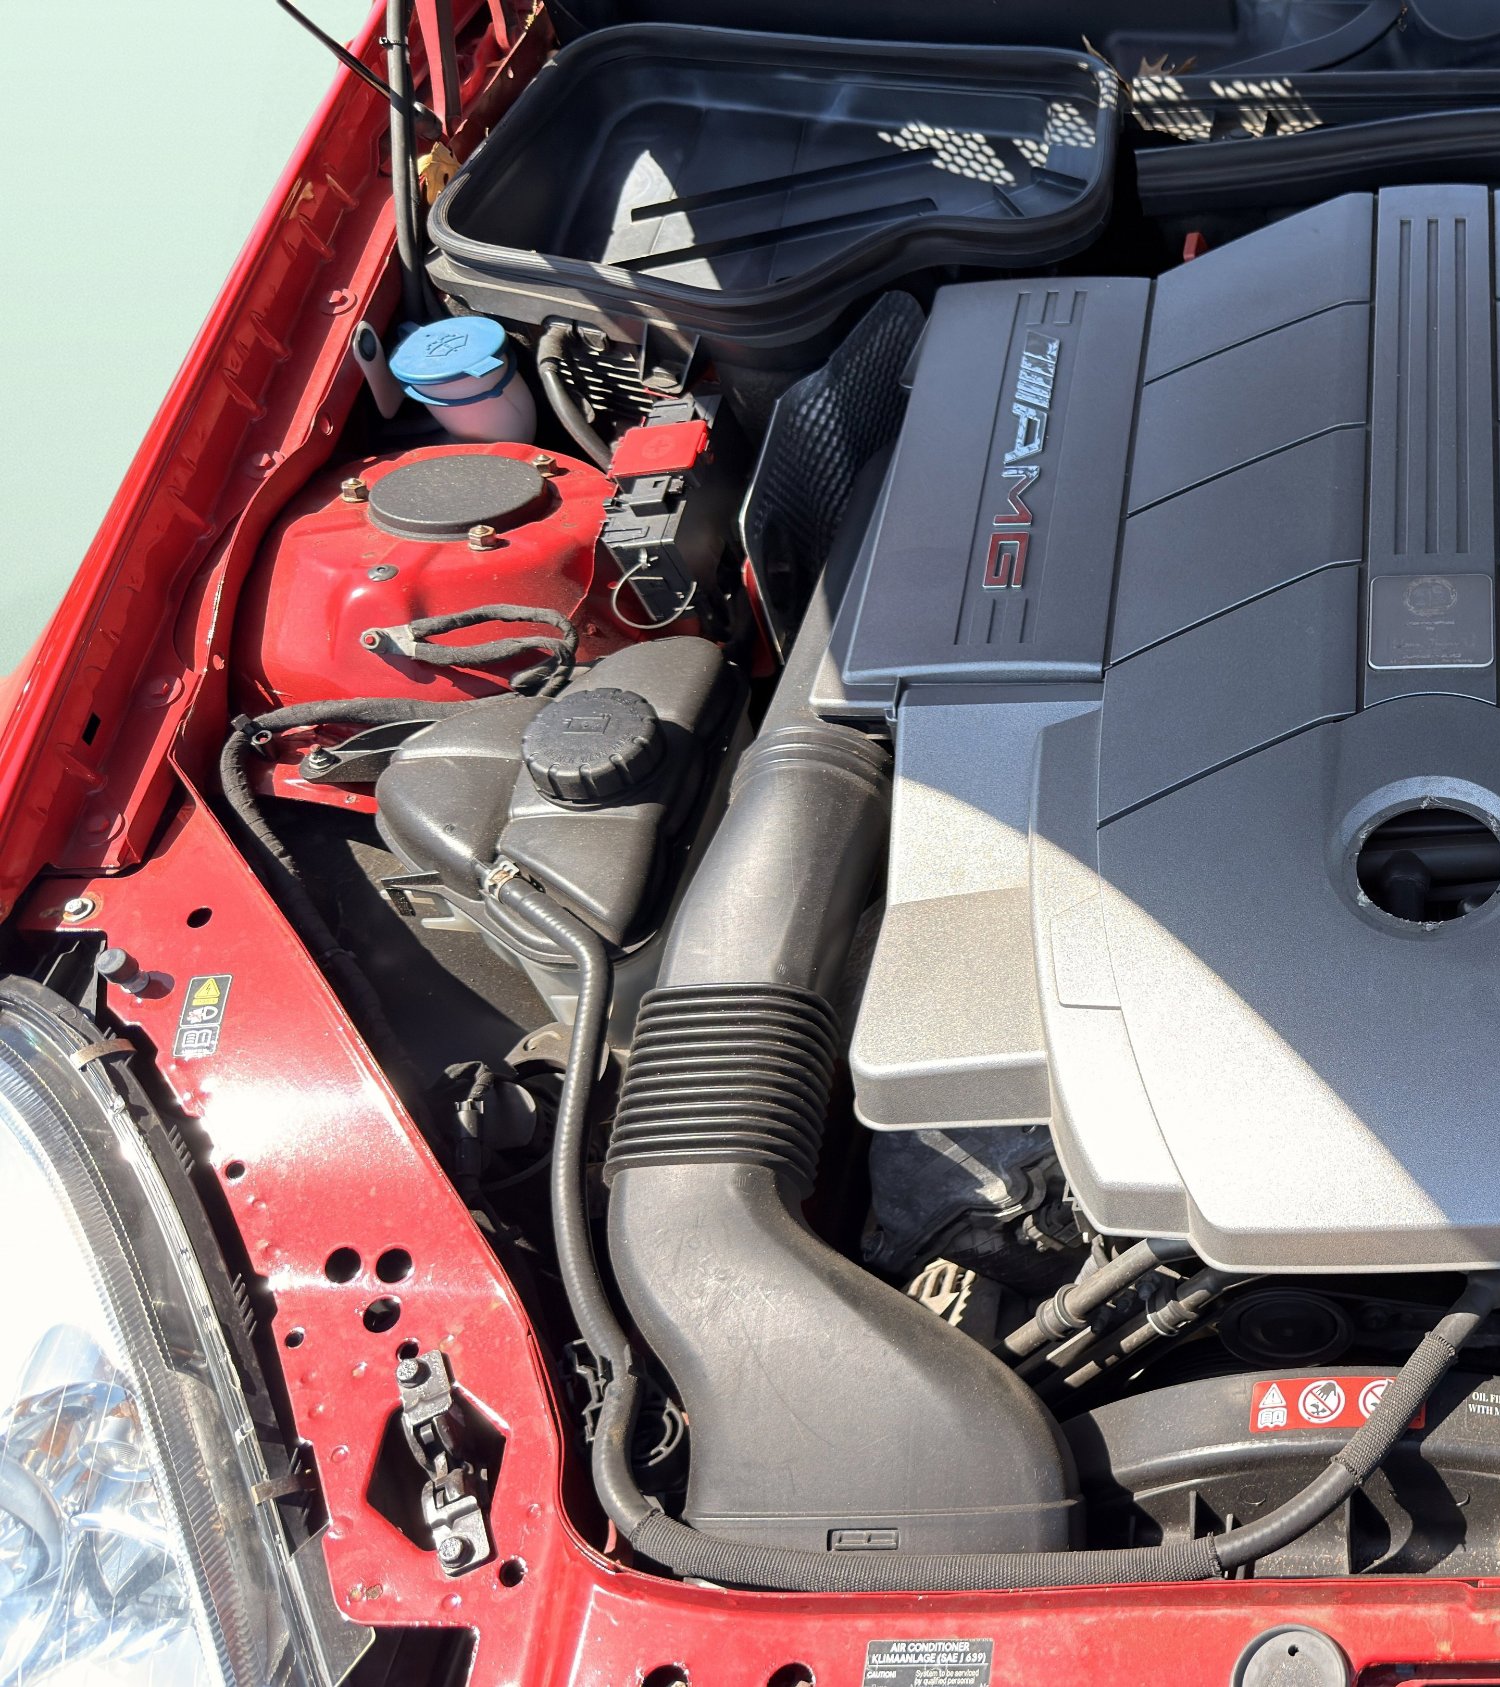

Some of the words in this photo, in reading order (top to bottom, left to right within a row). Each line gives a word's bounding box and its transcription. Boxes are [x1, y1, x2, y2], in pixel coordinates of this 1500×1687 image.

[1472, 1391, 1489, 1402] OIL
[1468, 1404, 1493, 1415] WITH
[890, 1642, 907, 1653] AIR
[907, 1642, 970, 1652] CONDITIONER
[871, 1653, 936, 1664] KLIMAANLAGE
[936, 1653, 957, 1664] (SAE
[965, 1652, 986, 1664] 639)
[915, 1669, 939, 1678] System
[939, 1669, 946, 1677] to
[946, 1669, 954, 1677] be
[955, 1668, 980, 1677] serviced
[914, 1677, 922, 1686] by
[923, 1676, 947, 1686] qualified
